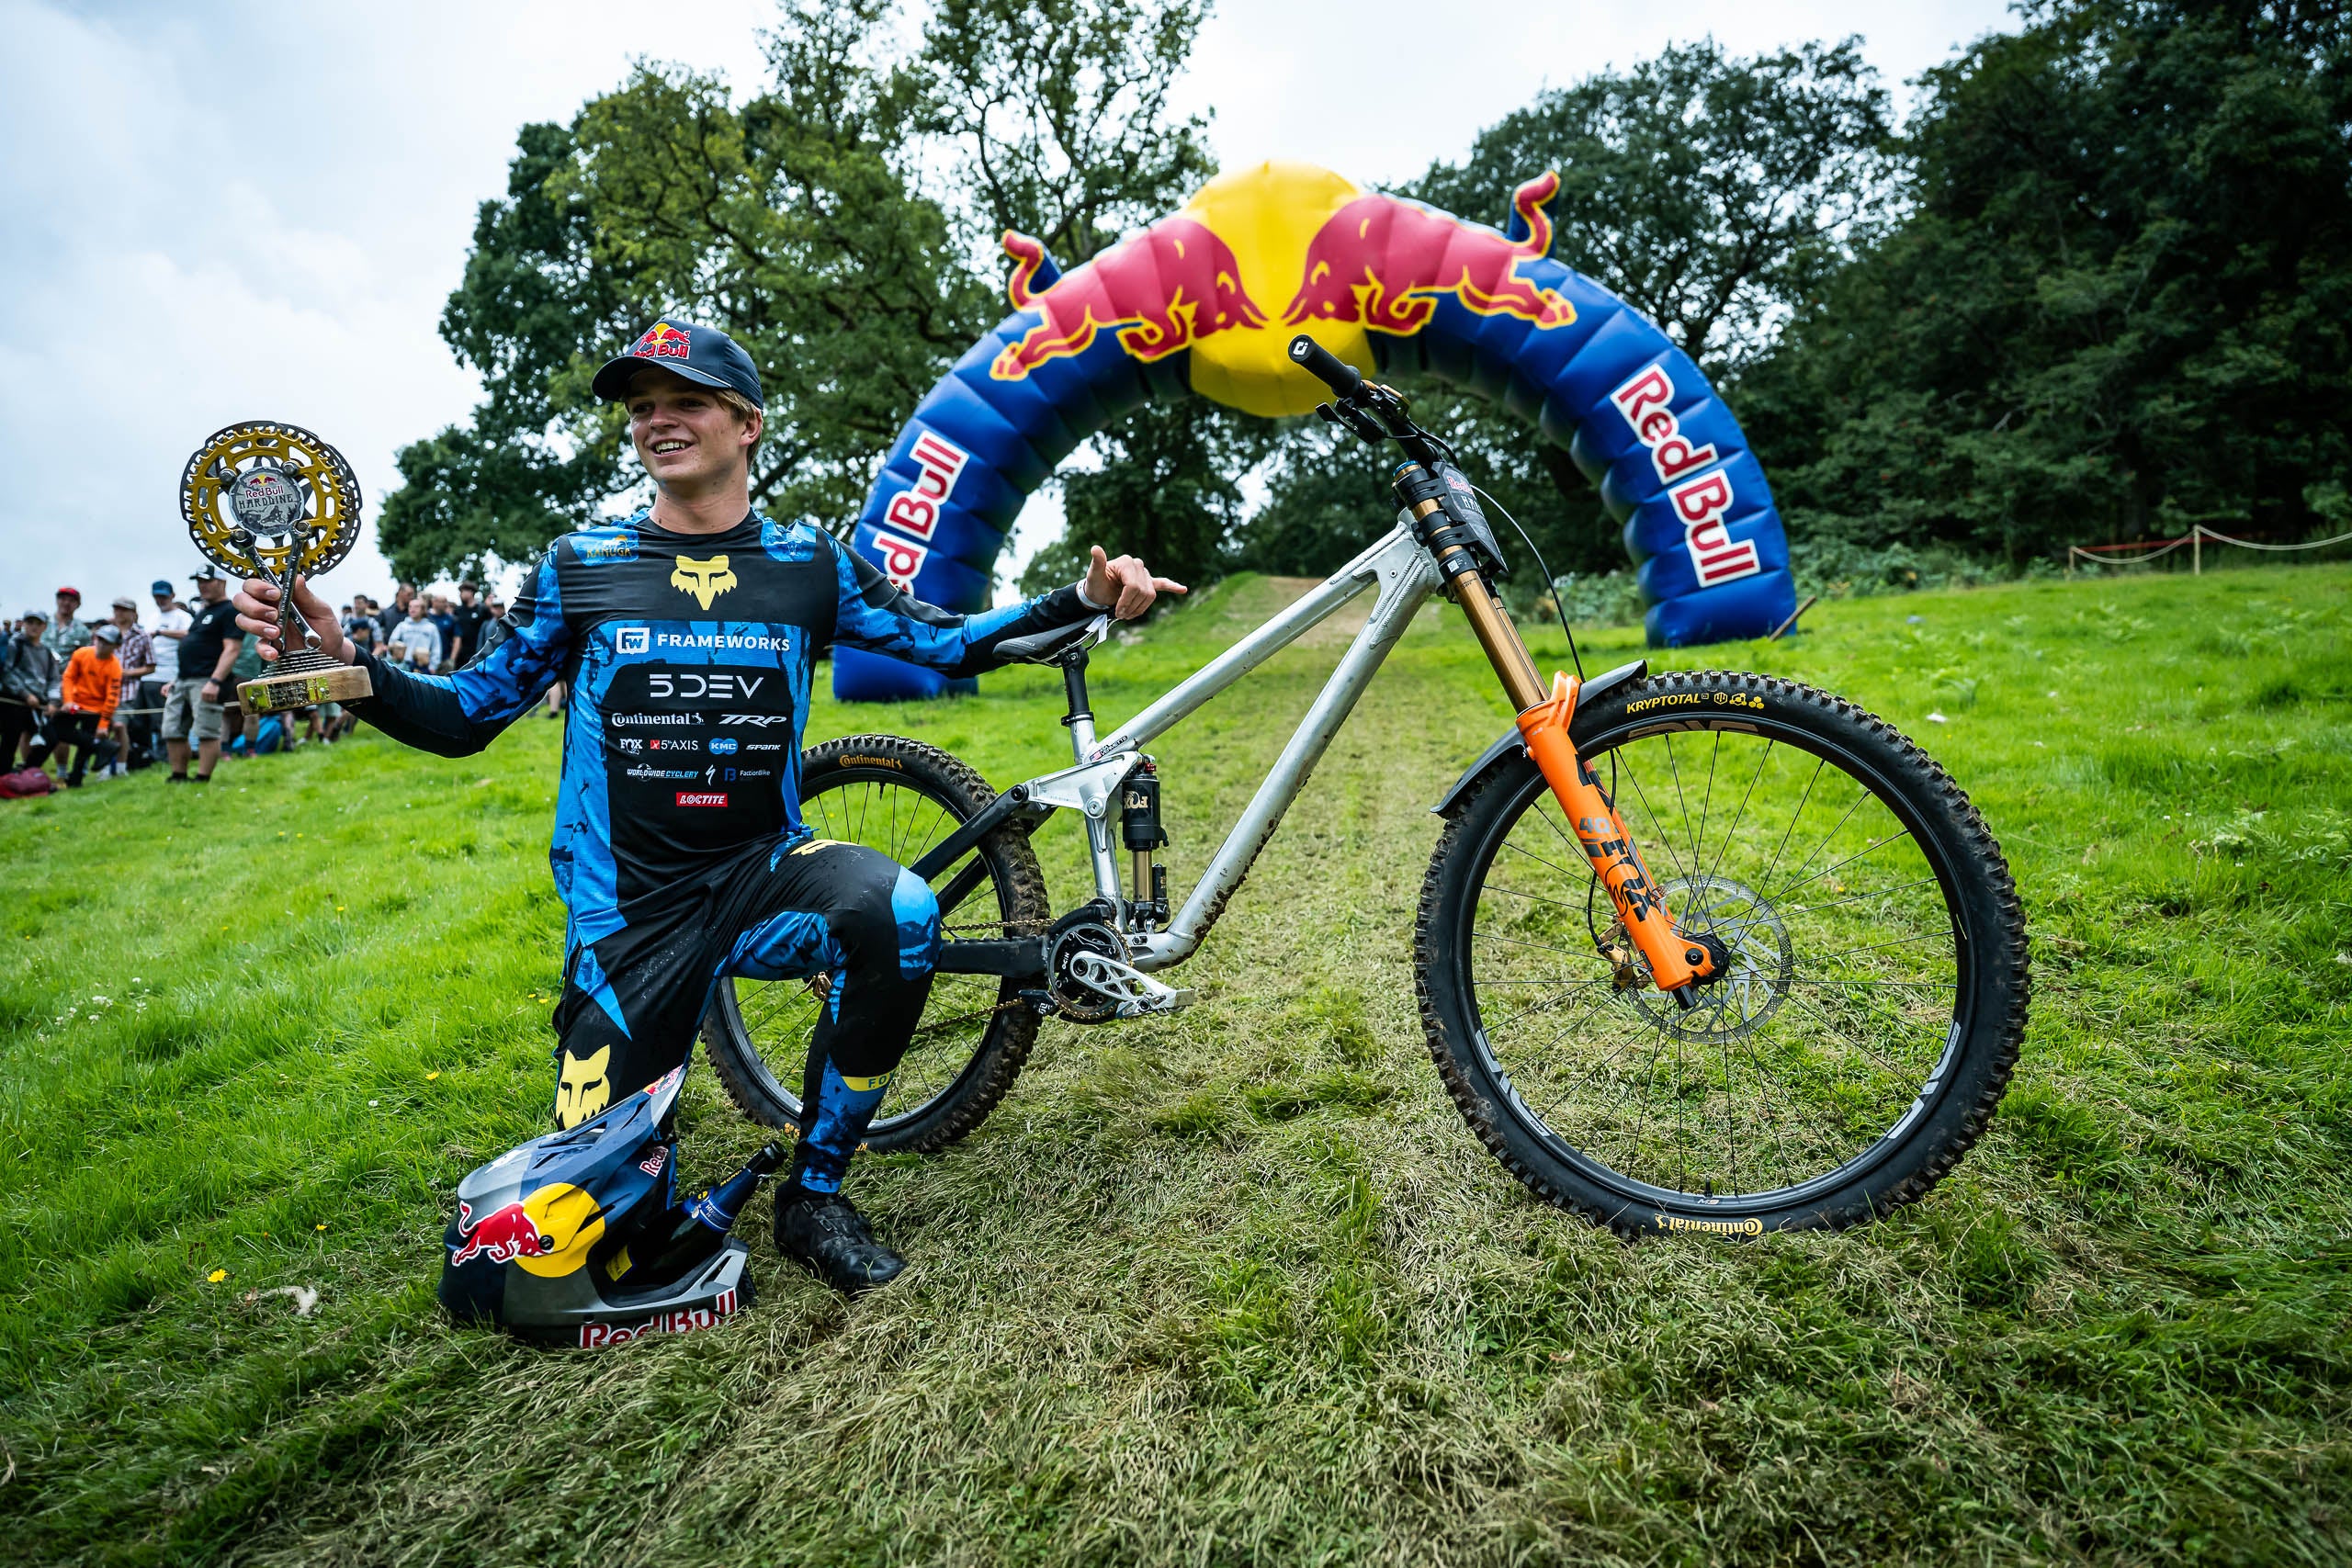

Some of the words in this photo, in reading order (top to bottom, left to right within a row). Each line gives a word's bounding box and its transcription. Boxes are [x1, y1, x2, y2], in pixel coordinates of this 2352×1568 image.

[657, 344, 688, 359] Bull
[1614, 368, 1715, 481] Red
[1671, 472, 1758, 583] Bull
[245, 488, 265, 498] Red
[265, 485, 284, 496] Bull
[887, 434, 965, 539] Bull
[657, 633, 790, 652] FRAMEWORKS
[1626, 693, 1702, 714] KRYPTOTAL
[611, 712, 690, 727] Continental
[718, 714, 787, 728] TRP
[619, 738, 643, 755] FOX
[710, 742, 737, 750] KMC
[839, 753, 895, 768] Continental
[679, 795, 725, 805] LOCTITE
[1124, 791, 1148, 809] FOX
[1668, 1217, 1763, 1236] Continental
[666, 1289, 737, 1334] Bull
